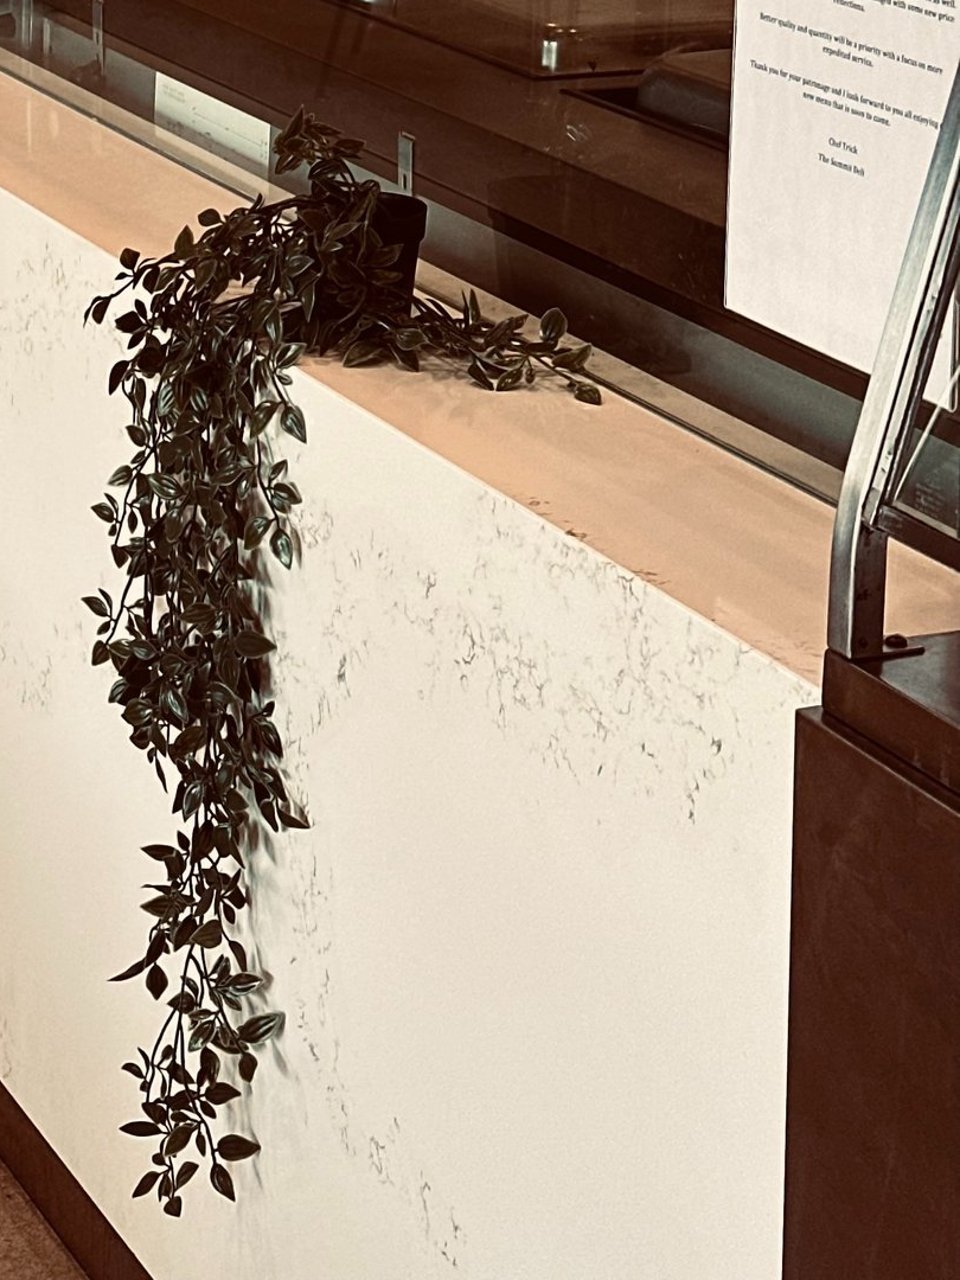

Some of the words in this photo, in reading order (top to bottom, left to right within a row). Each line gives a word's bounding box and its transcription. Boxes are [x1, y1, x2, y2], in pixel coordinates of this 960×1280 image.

[893, 0, 906, 10] with
[908, 4, 923, 14] some
[924, 9, 937, 18] new
[938, 13, 955, 23] price
[941, 0, 956, 8] well.
[778, 19, 796, 32] quality
[797, 24, 807, 34] and
[808, 28, 832, 43] quantity
[833, 36, 845, 45] will
[846, 38, 852, 47] be
[858, 43, 881, 56] priority
[882, 51, 895, 60] with
[901, 54, 917, 67] focus
[918, 62, 926, 70] on
[927, 65, 943, 75] more
[750, 59, 768, 72] Thank
[768, 67, 779, 75] you
[779, 69, 788, 78] for
[788, 73, 801, 82] your
[802, 78, 831, 93] patronage
[831, 87, 841, 96] and
[846, 89, 859, 102] look
[860, 95, 884, 110] forward
[885, 104, 891, 112] to
[892, 107, 903, 116] you
[904, 110, 912, 119] all
[913, 114, 938, 130] enjoying
[803, 92, 814, 100] new
[815, 96, 832, 106] menu
[832, 100, 843, 110] that
[851, 108, 864, 117] soon
[865, 112, 872, 120] to
[873, 115, 891, 126] come.
[818, 152, 829, 163] The
